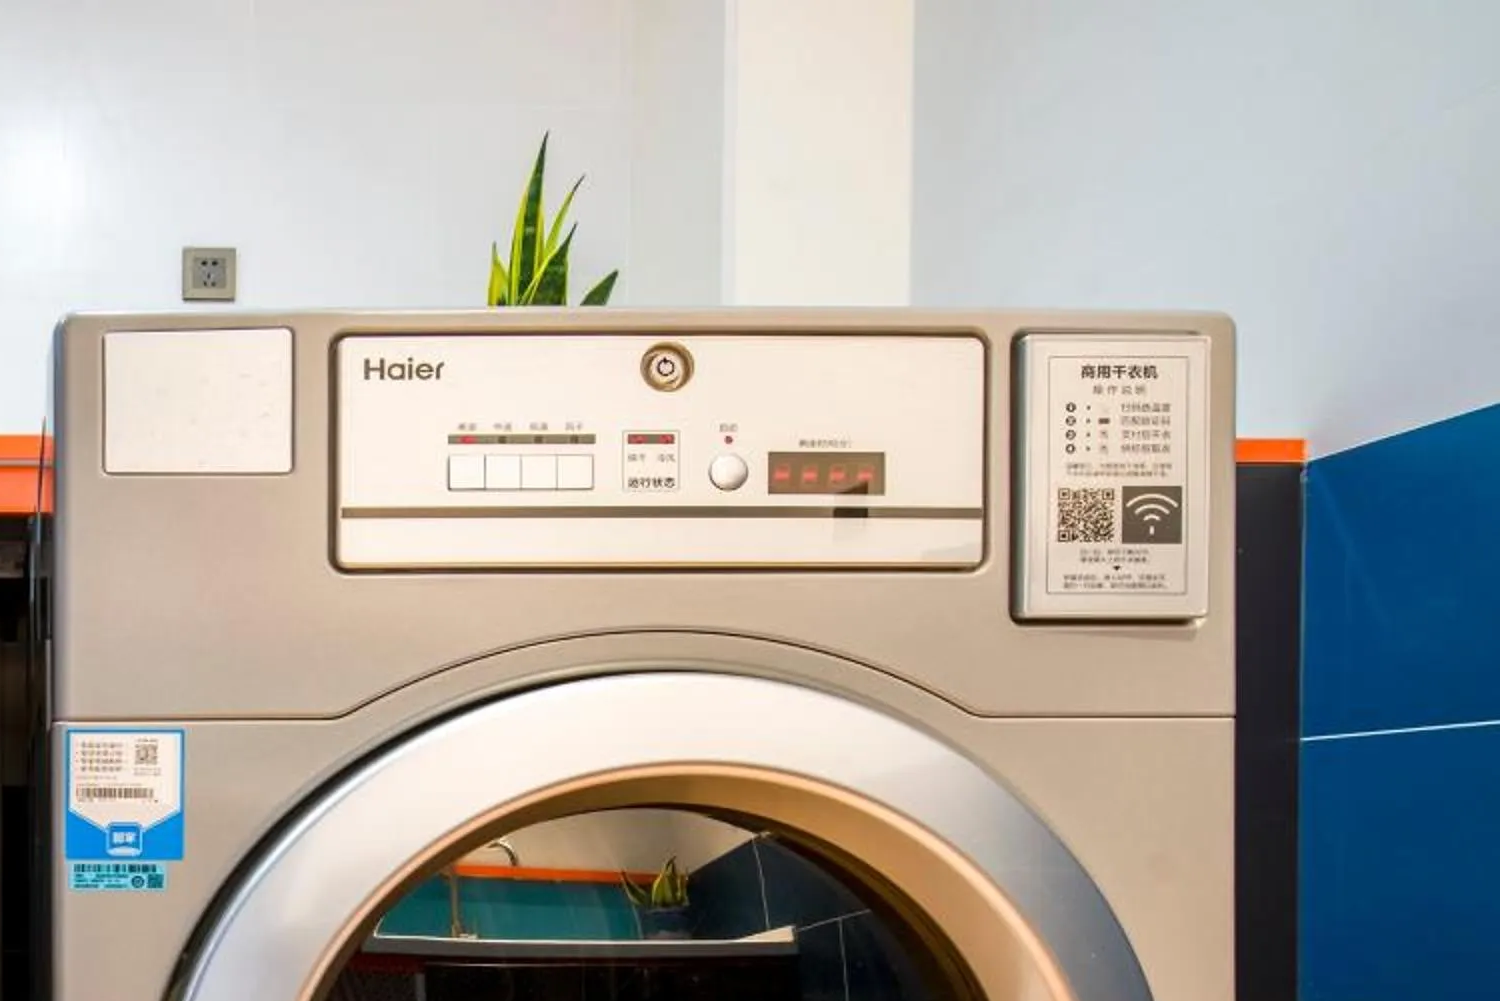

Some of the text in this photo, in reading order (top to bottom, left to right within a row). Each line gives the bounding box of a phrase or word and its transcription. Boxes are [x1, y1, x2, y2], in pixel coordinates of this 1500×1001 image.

[363, 357, 445, 381] Haier
[1081, 365, 1159, 379] 商用干衣机
